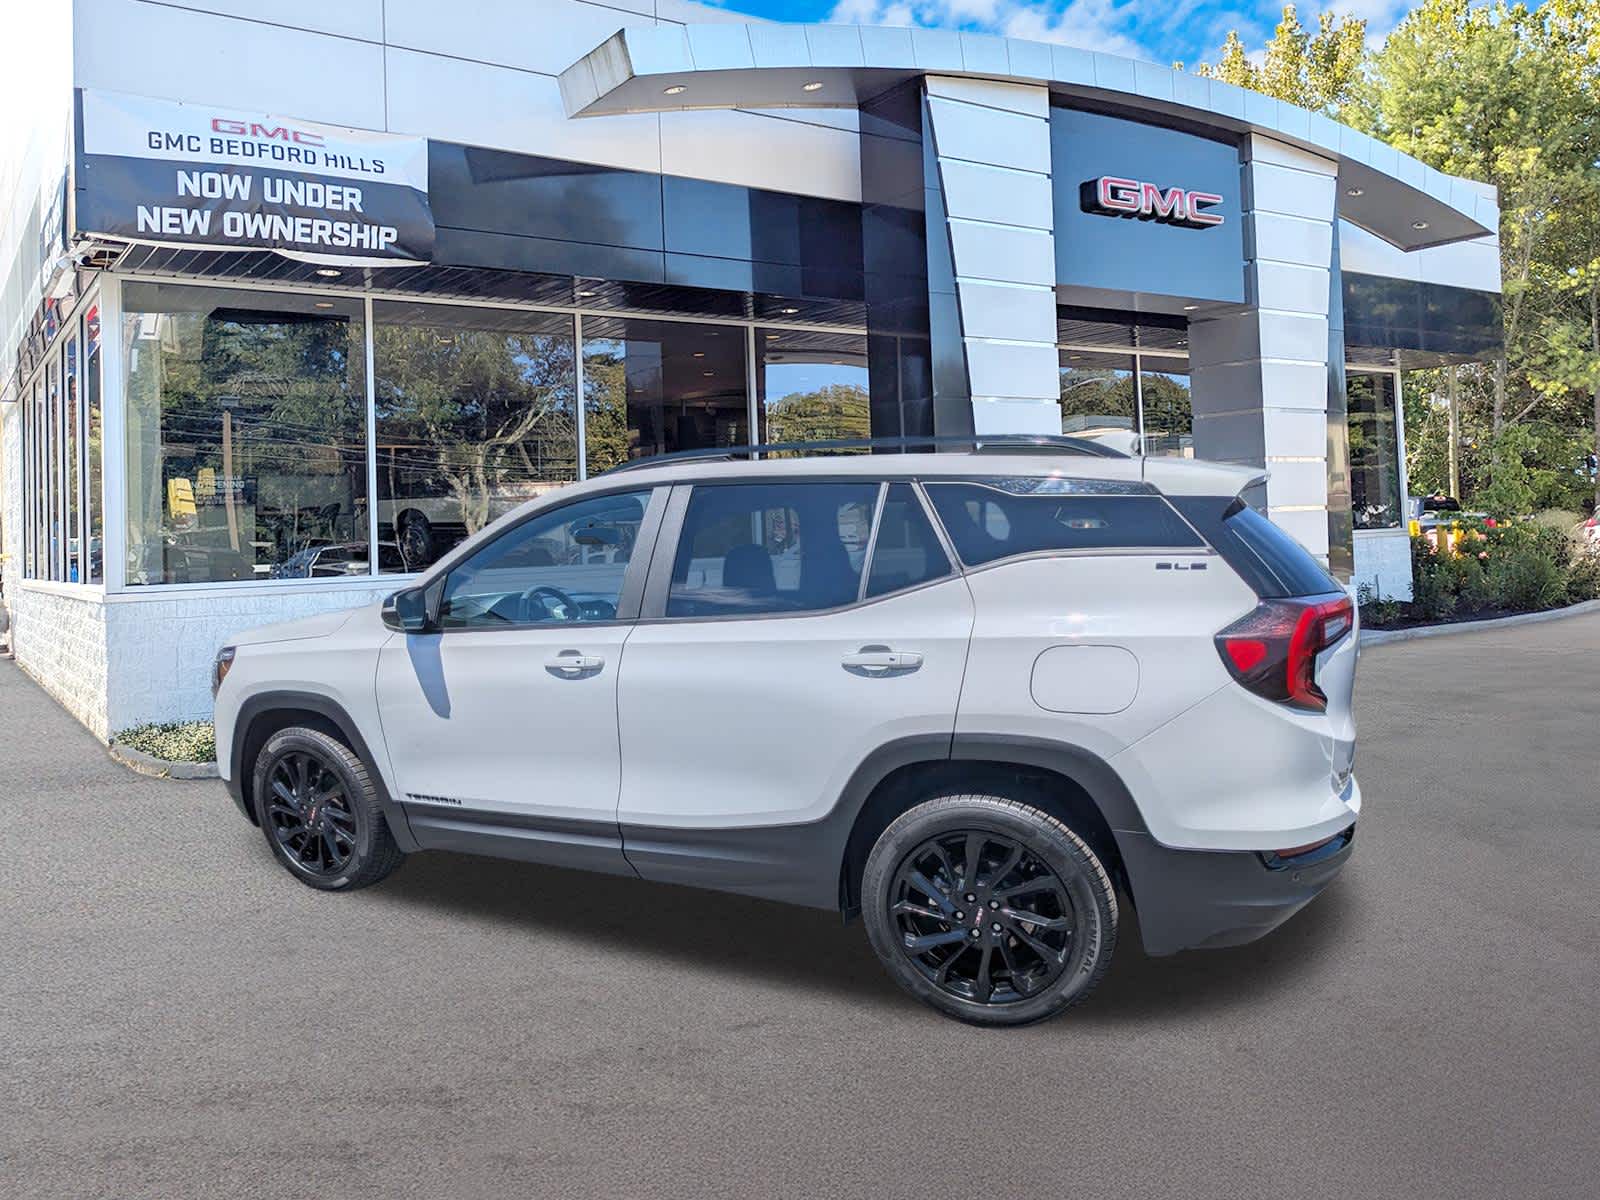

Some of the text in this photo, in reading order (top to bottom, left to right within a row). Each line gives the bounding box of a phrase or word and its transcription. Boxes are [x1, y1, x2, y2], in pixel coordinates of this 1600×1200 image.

[148, 131, 385, 174] GMC BEDFORD HILLS
[211, 118, 326, 148] GMC
[177, 170, 364, 213] NOW UNDER
[1097, 175, 1225, 225] GMC
[136, 205, 398, 250] NEW OWNERSHIP
